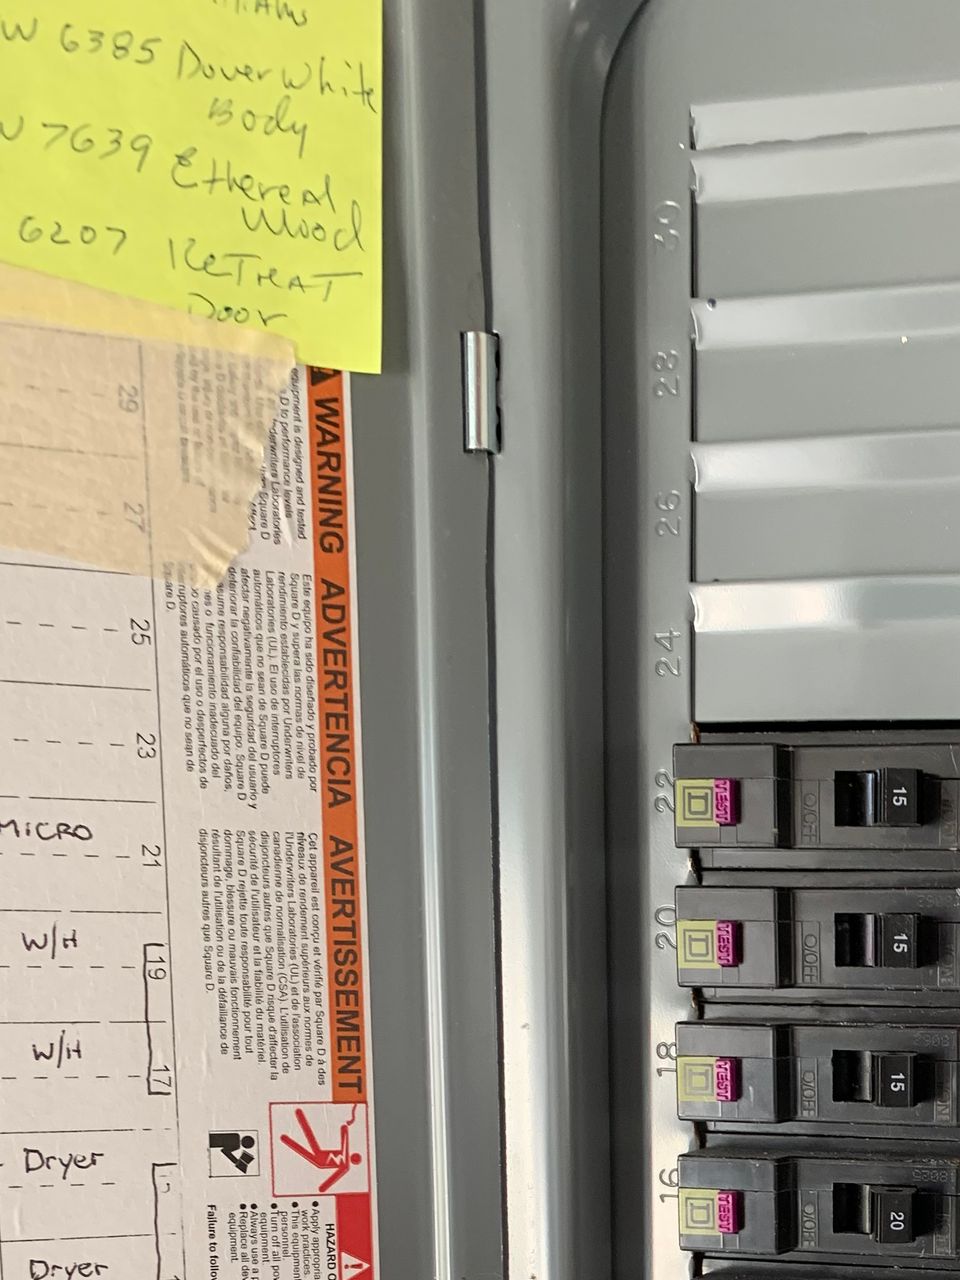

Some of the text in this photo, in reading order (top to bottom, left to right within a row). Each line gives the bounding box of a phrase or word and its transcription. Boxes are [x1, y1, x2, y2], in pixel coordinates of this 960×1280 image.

[59, 24, 161, 65] 6385
[41, 119, 152, 172] 7639
[209, 95, 308, 159] Body
[19, 216, 127, 255] 6207
[315, 396, 344, 554] WARNING
[122, 503, 145, 535] 27
[130, 618, 151, 645] 25
[320, 578, 352, 809] ADVERTENCIA
[136, 733, 156, 759] 23
[715, 780, 730, 823] TEST
[893, 786, 906, 806] 15
[142, 844, 161, 867] 21
[22, 921, 77, 960] W/H
[716, 923, 731, 964] TEST
[894, 933, 907, 952] 15
[148, 956, 166, 980] 19
[329, 835, 362, 1094] AVERTISSEMENT
[32, 1030, 81, 1068] W/H
[152, 1065, 172, 1087] 17
[717, 1060, 731, 1102] TEST
[891, 1072, 904, 1092] 15
[24, 1148, 104, 1179] Dryer
[718, 1193, 731, 1233] TEST
[890, 1212, 904, 1231] 20
[325, 1223, 337, 1270] HAZARD
